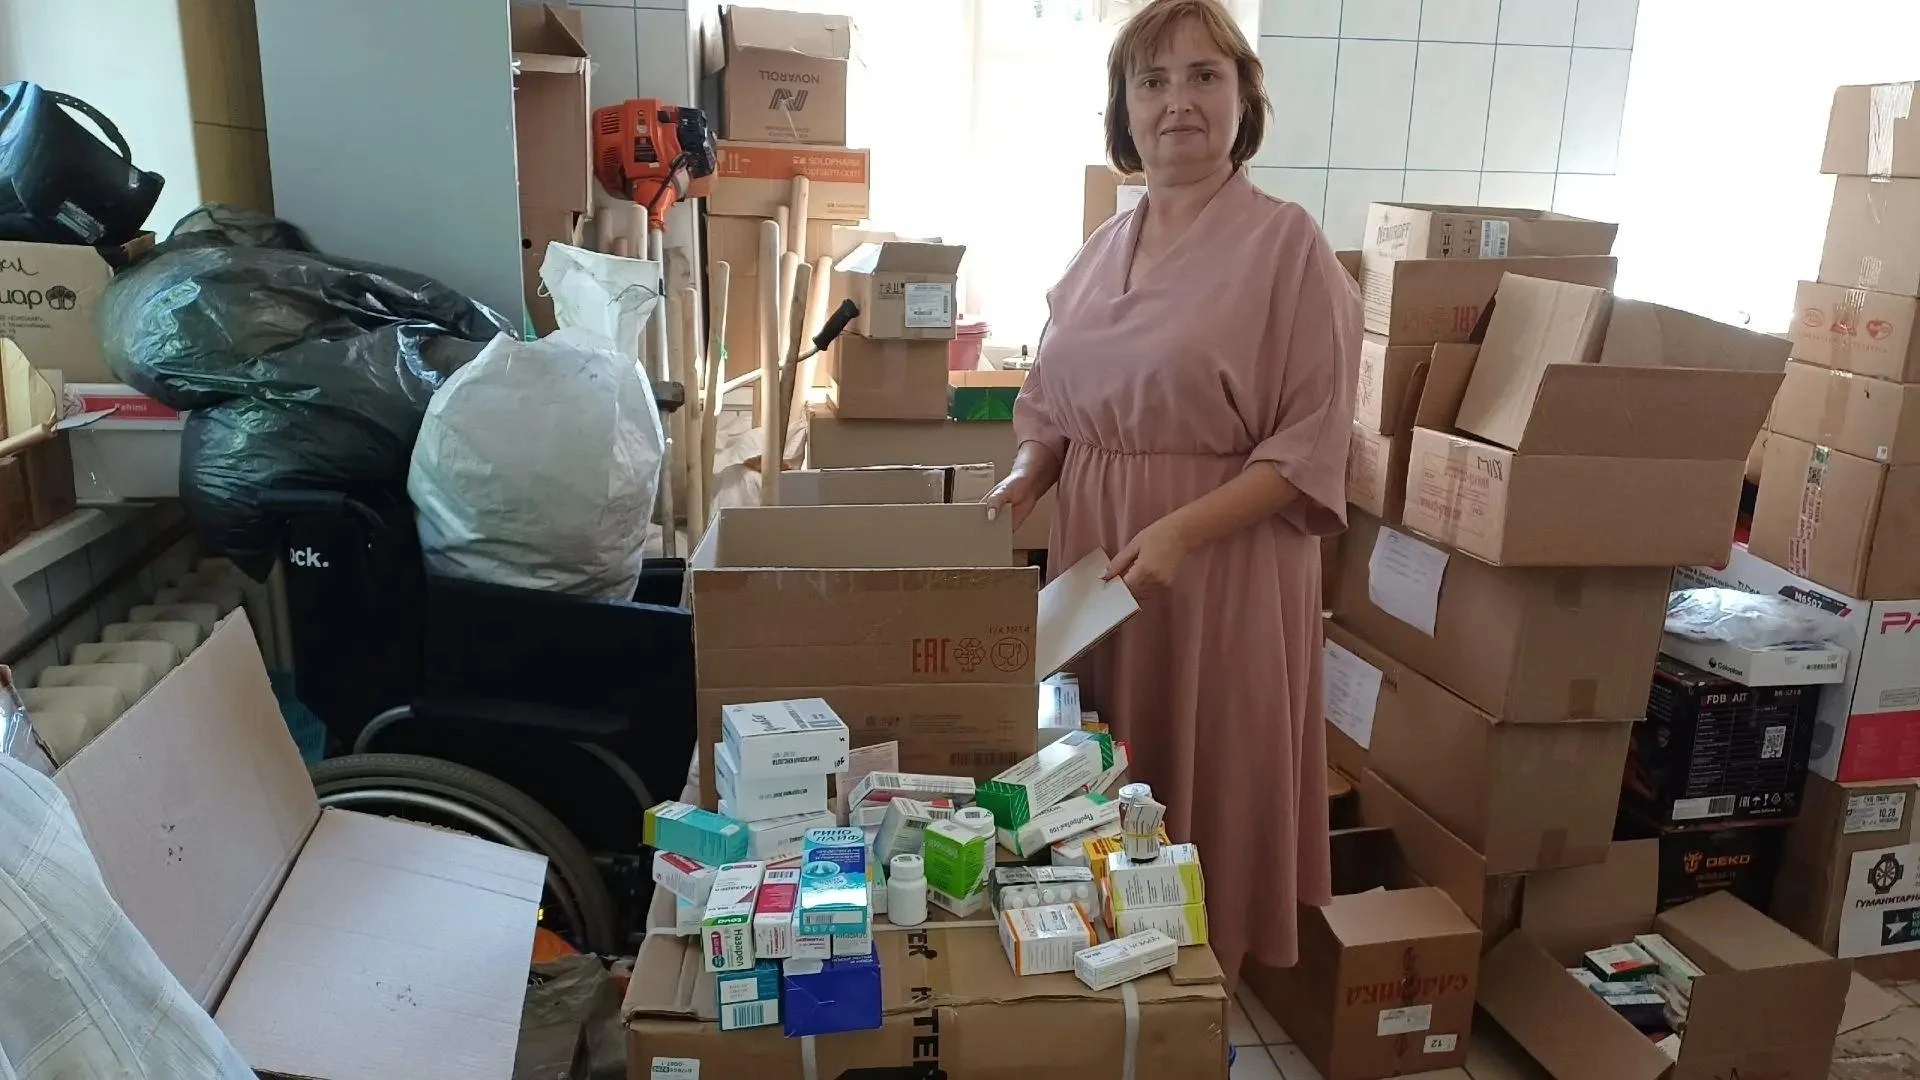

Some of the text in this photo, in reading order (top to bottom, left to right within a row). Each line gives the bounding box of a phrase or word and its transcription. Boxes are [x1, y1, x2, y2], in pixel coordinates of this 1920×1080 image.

[760, 70, 820, 84] NOVAROLL
[911, 637, 951, 674] EAC
[1717, 661, 1744, 677] Coloplast
[1706, 854, 1751, 869] DEKO
[733, 928, 744, 967] Назарел
